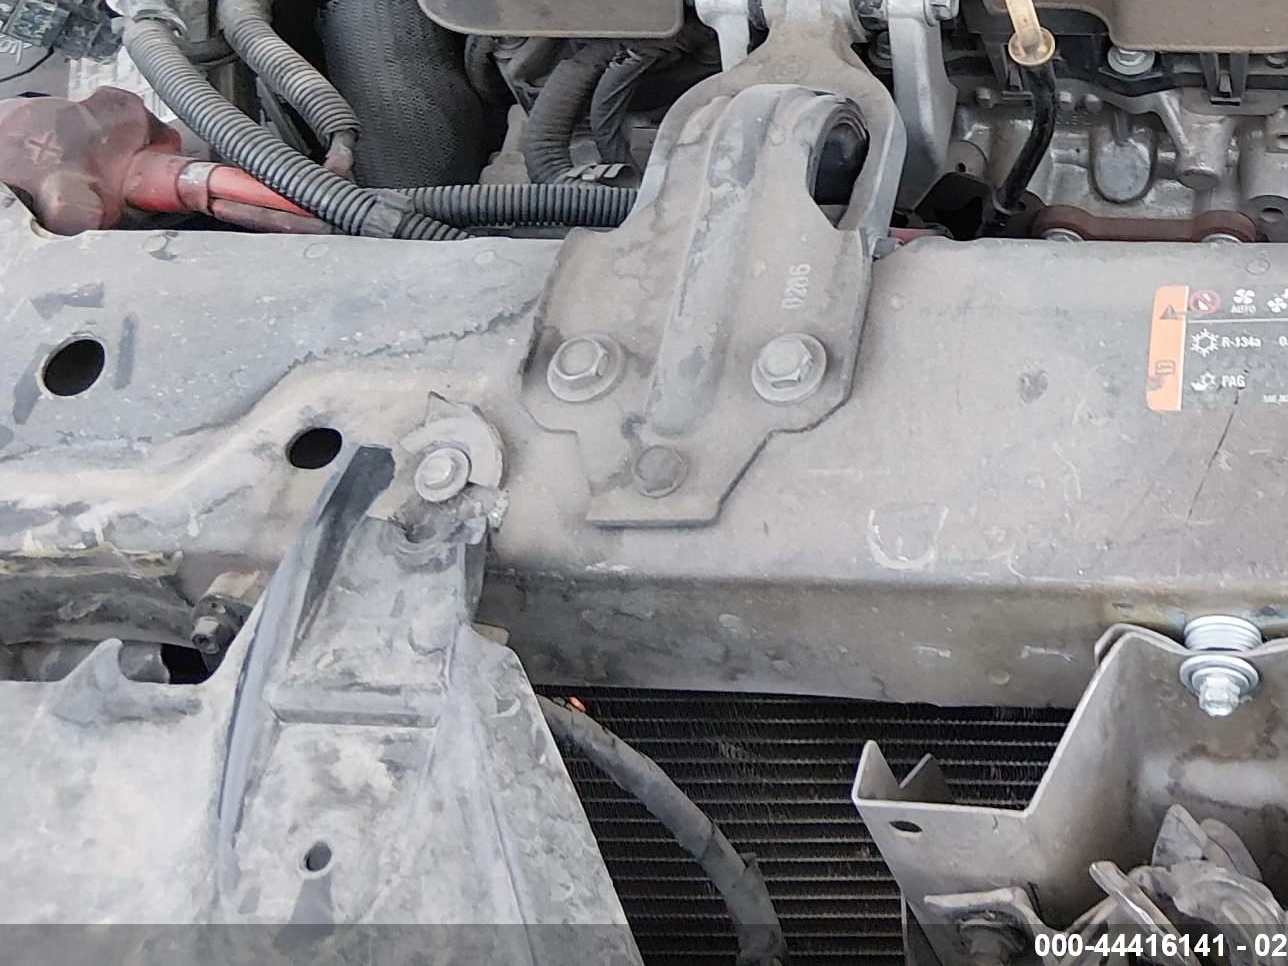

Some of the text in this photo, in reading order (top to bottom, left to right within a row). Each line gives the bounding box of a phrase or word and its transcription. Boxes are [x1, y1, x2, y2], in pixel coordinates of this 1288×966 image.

[1230, 305, 1257, 314] AUTO
[1221, 336, 1262, 348] R-134a
[1221, 375, 1247, 388] PAG
